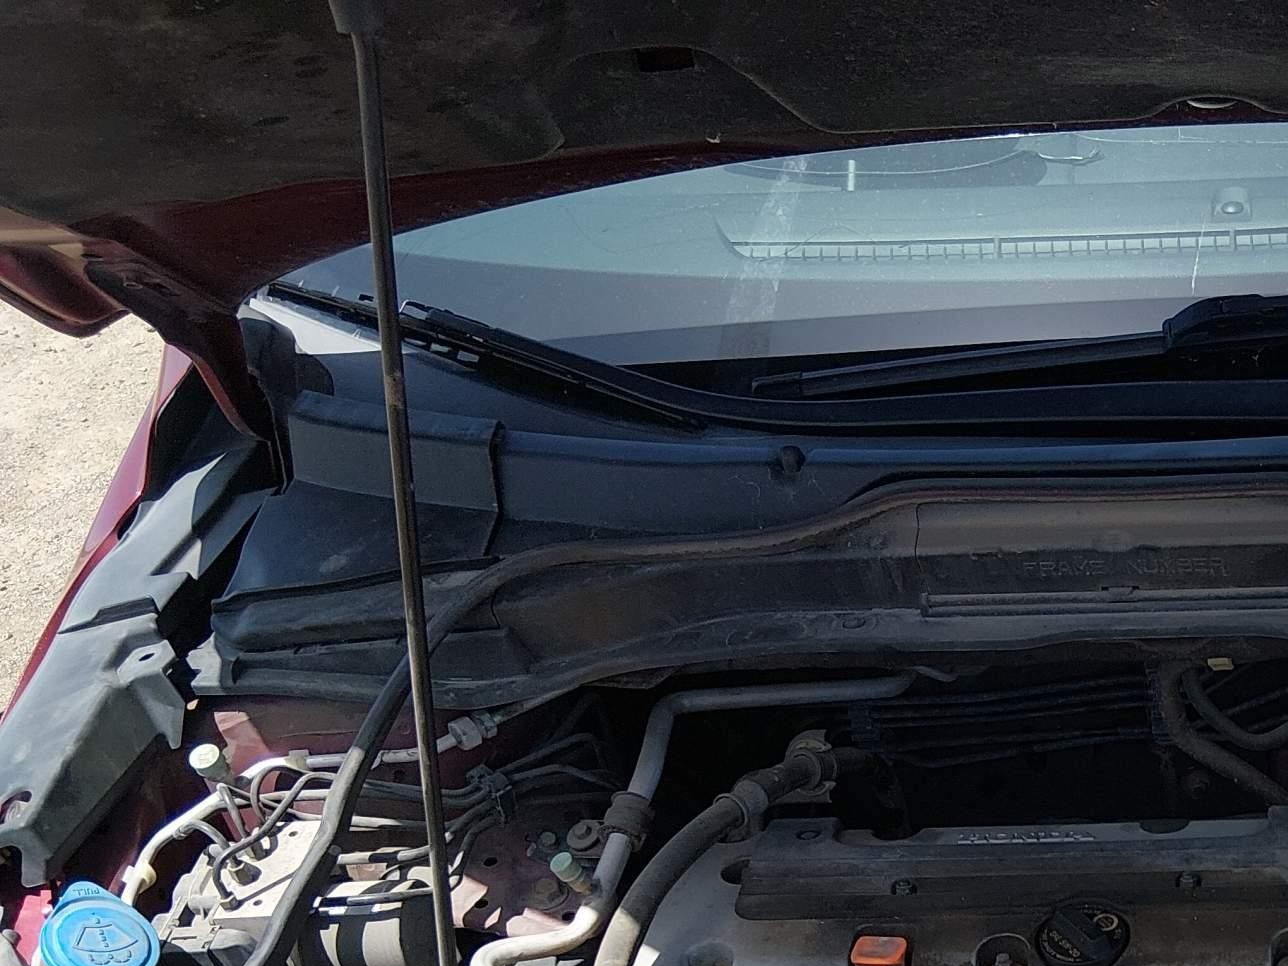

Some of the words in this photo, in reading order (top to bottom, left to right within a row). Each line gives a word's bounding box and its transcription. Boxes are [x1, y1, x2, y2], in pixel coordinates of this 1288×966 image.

[1023, 558, 1106, 578] FRAME
[1126, 556, 1231, 578] NUMBER
[71, 886, 100, 897] PULL
